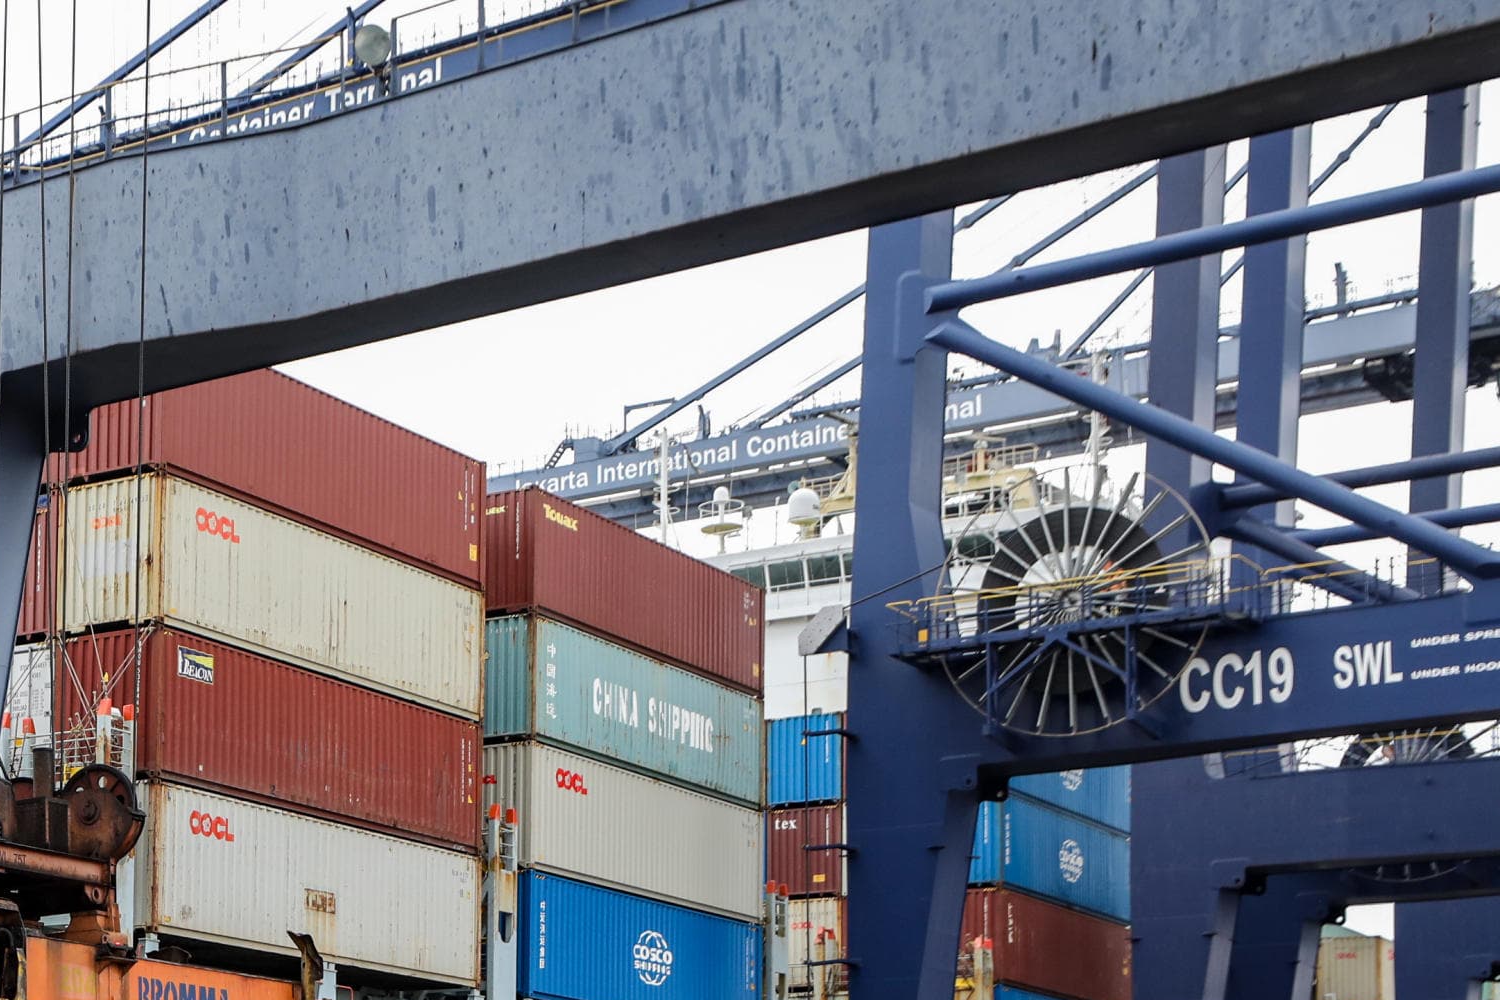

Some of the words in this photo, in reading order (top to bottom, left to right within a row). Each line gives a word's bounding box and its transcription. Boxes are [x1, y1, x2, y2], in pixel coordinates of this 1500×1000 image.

[325, 57, 442, 112] Ternal
[746, 423, 847, 456] Containe
[196, 507, 240, 544] OOCL
[543, 503, 578, 531] Touax
[1410, 633, 1460, 648] UNDER
[1463, 628, 1500, 642] SPRE
[1180, 647, 1294, 713] CC19
[1333, 640, 1404, 689] SWL
[1410, 665, 1460, 680] UNDER
[592, 677, 639, 728] CHINA
[556, 767, 588, 795] OOCL
[189, 809, 235, 842] OOCL
[774, 817, 797, 830] tex
[633, 943, 673, 965] COSCO
